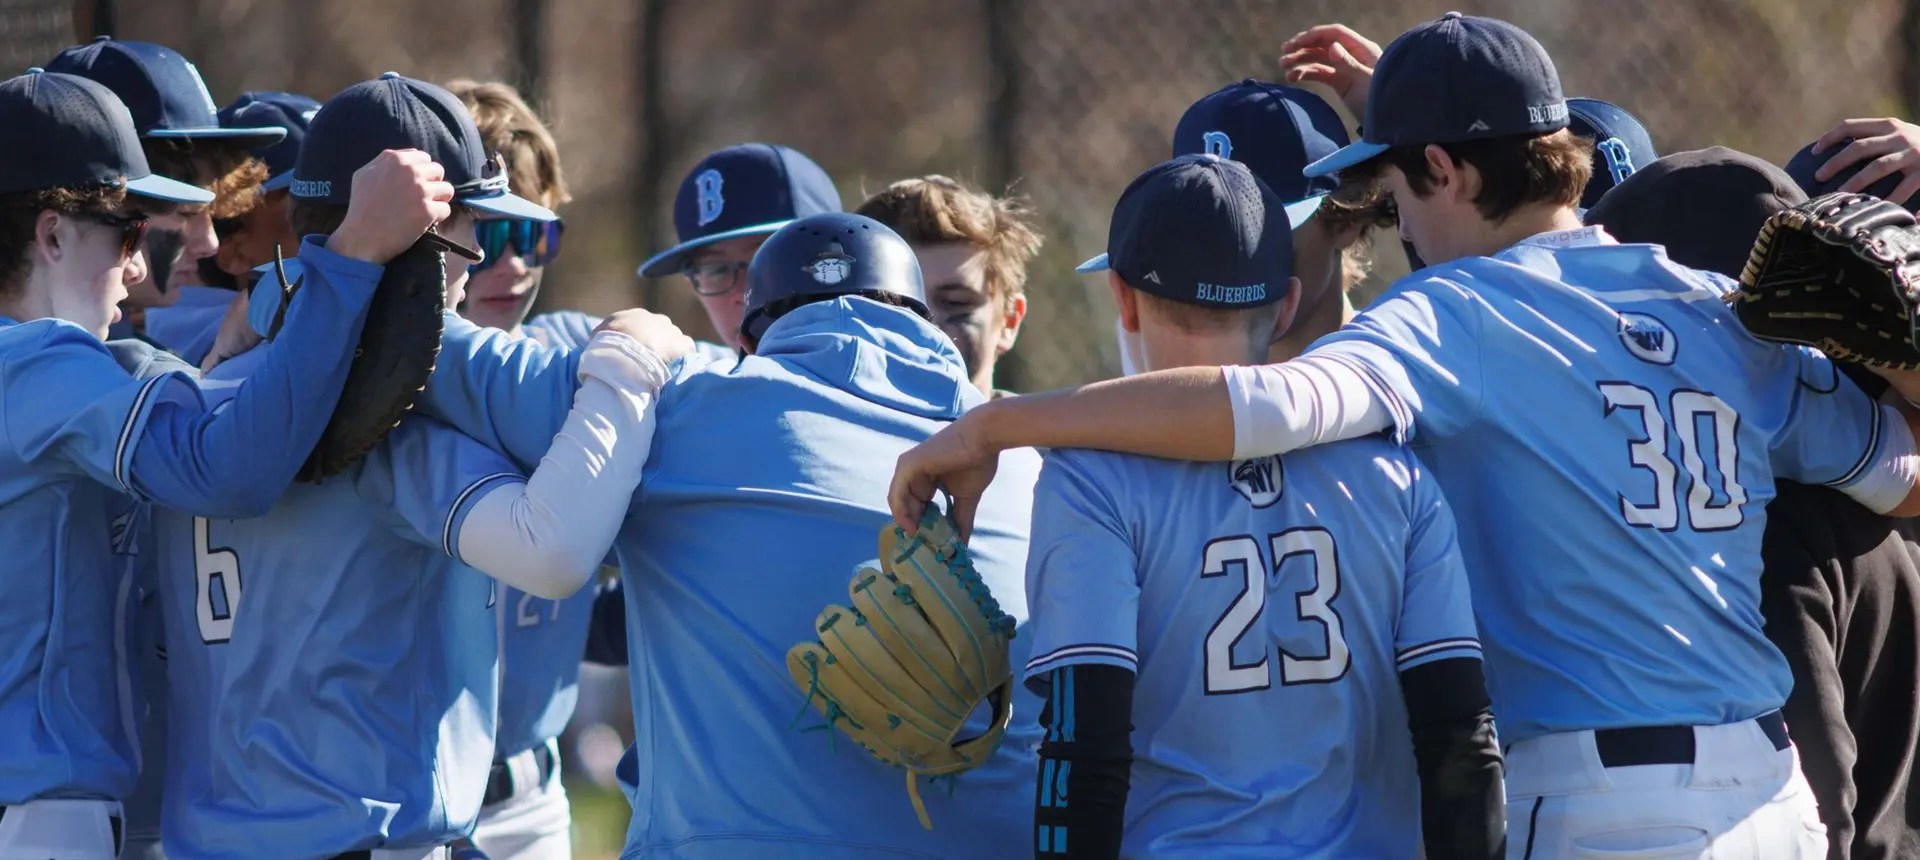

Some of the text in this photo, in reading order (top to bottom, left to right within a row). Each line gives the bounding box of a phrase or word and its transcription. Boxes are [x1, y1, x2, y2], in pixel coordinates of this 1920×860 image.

[695, 168, 724, 227] B
[1597, 137, 1636, 186] B
[1196, 282, 1266, 303] BLUEBIRDS
[1596, 380, 1748, 532] 30
[192, 516, 243, 645] 6
[1200, 526, 1352, 696] 23
